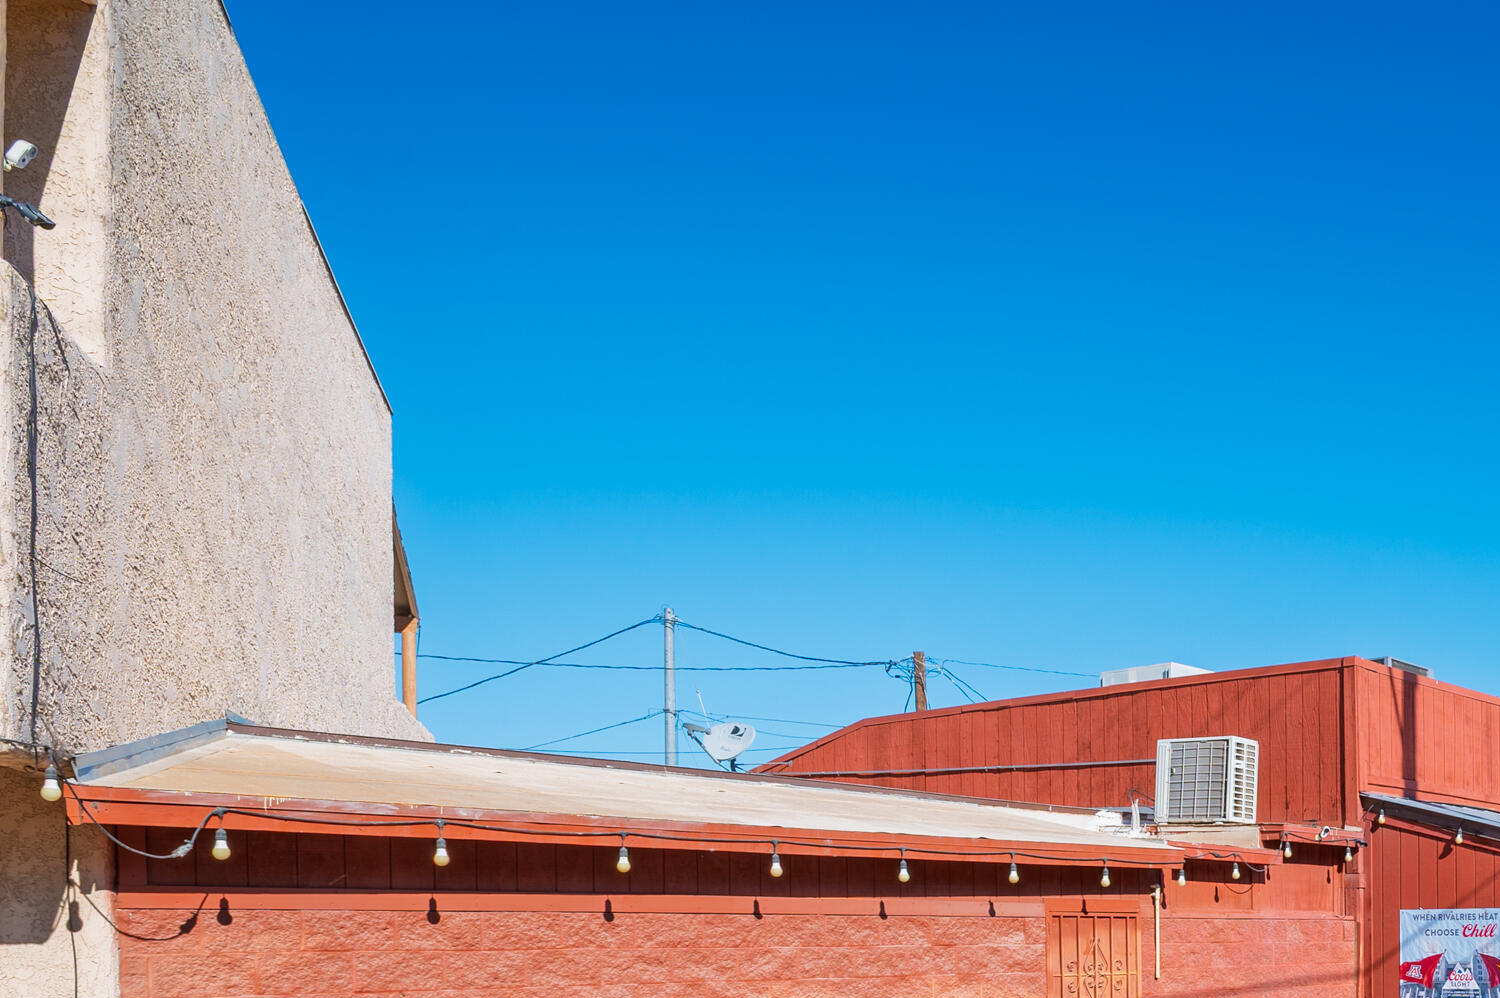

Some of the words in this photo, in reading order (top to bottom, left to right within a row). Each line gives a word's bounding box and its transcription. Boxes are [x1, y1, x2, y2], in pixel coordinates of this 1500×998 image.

[1412, 913, 1436, 921] WHEN
[1438, 912, 1477, 921] RIVALRIES
[1478, 912, 1498, 920] HEAT
[1424, 928, 1460, 937] CHOOSE
[1461, 922, 1498, 938] Chill
[1448, 969, 1474, 982] Coors
